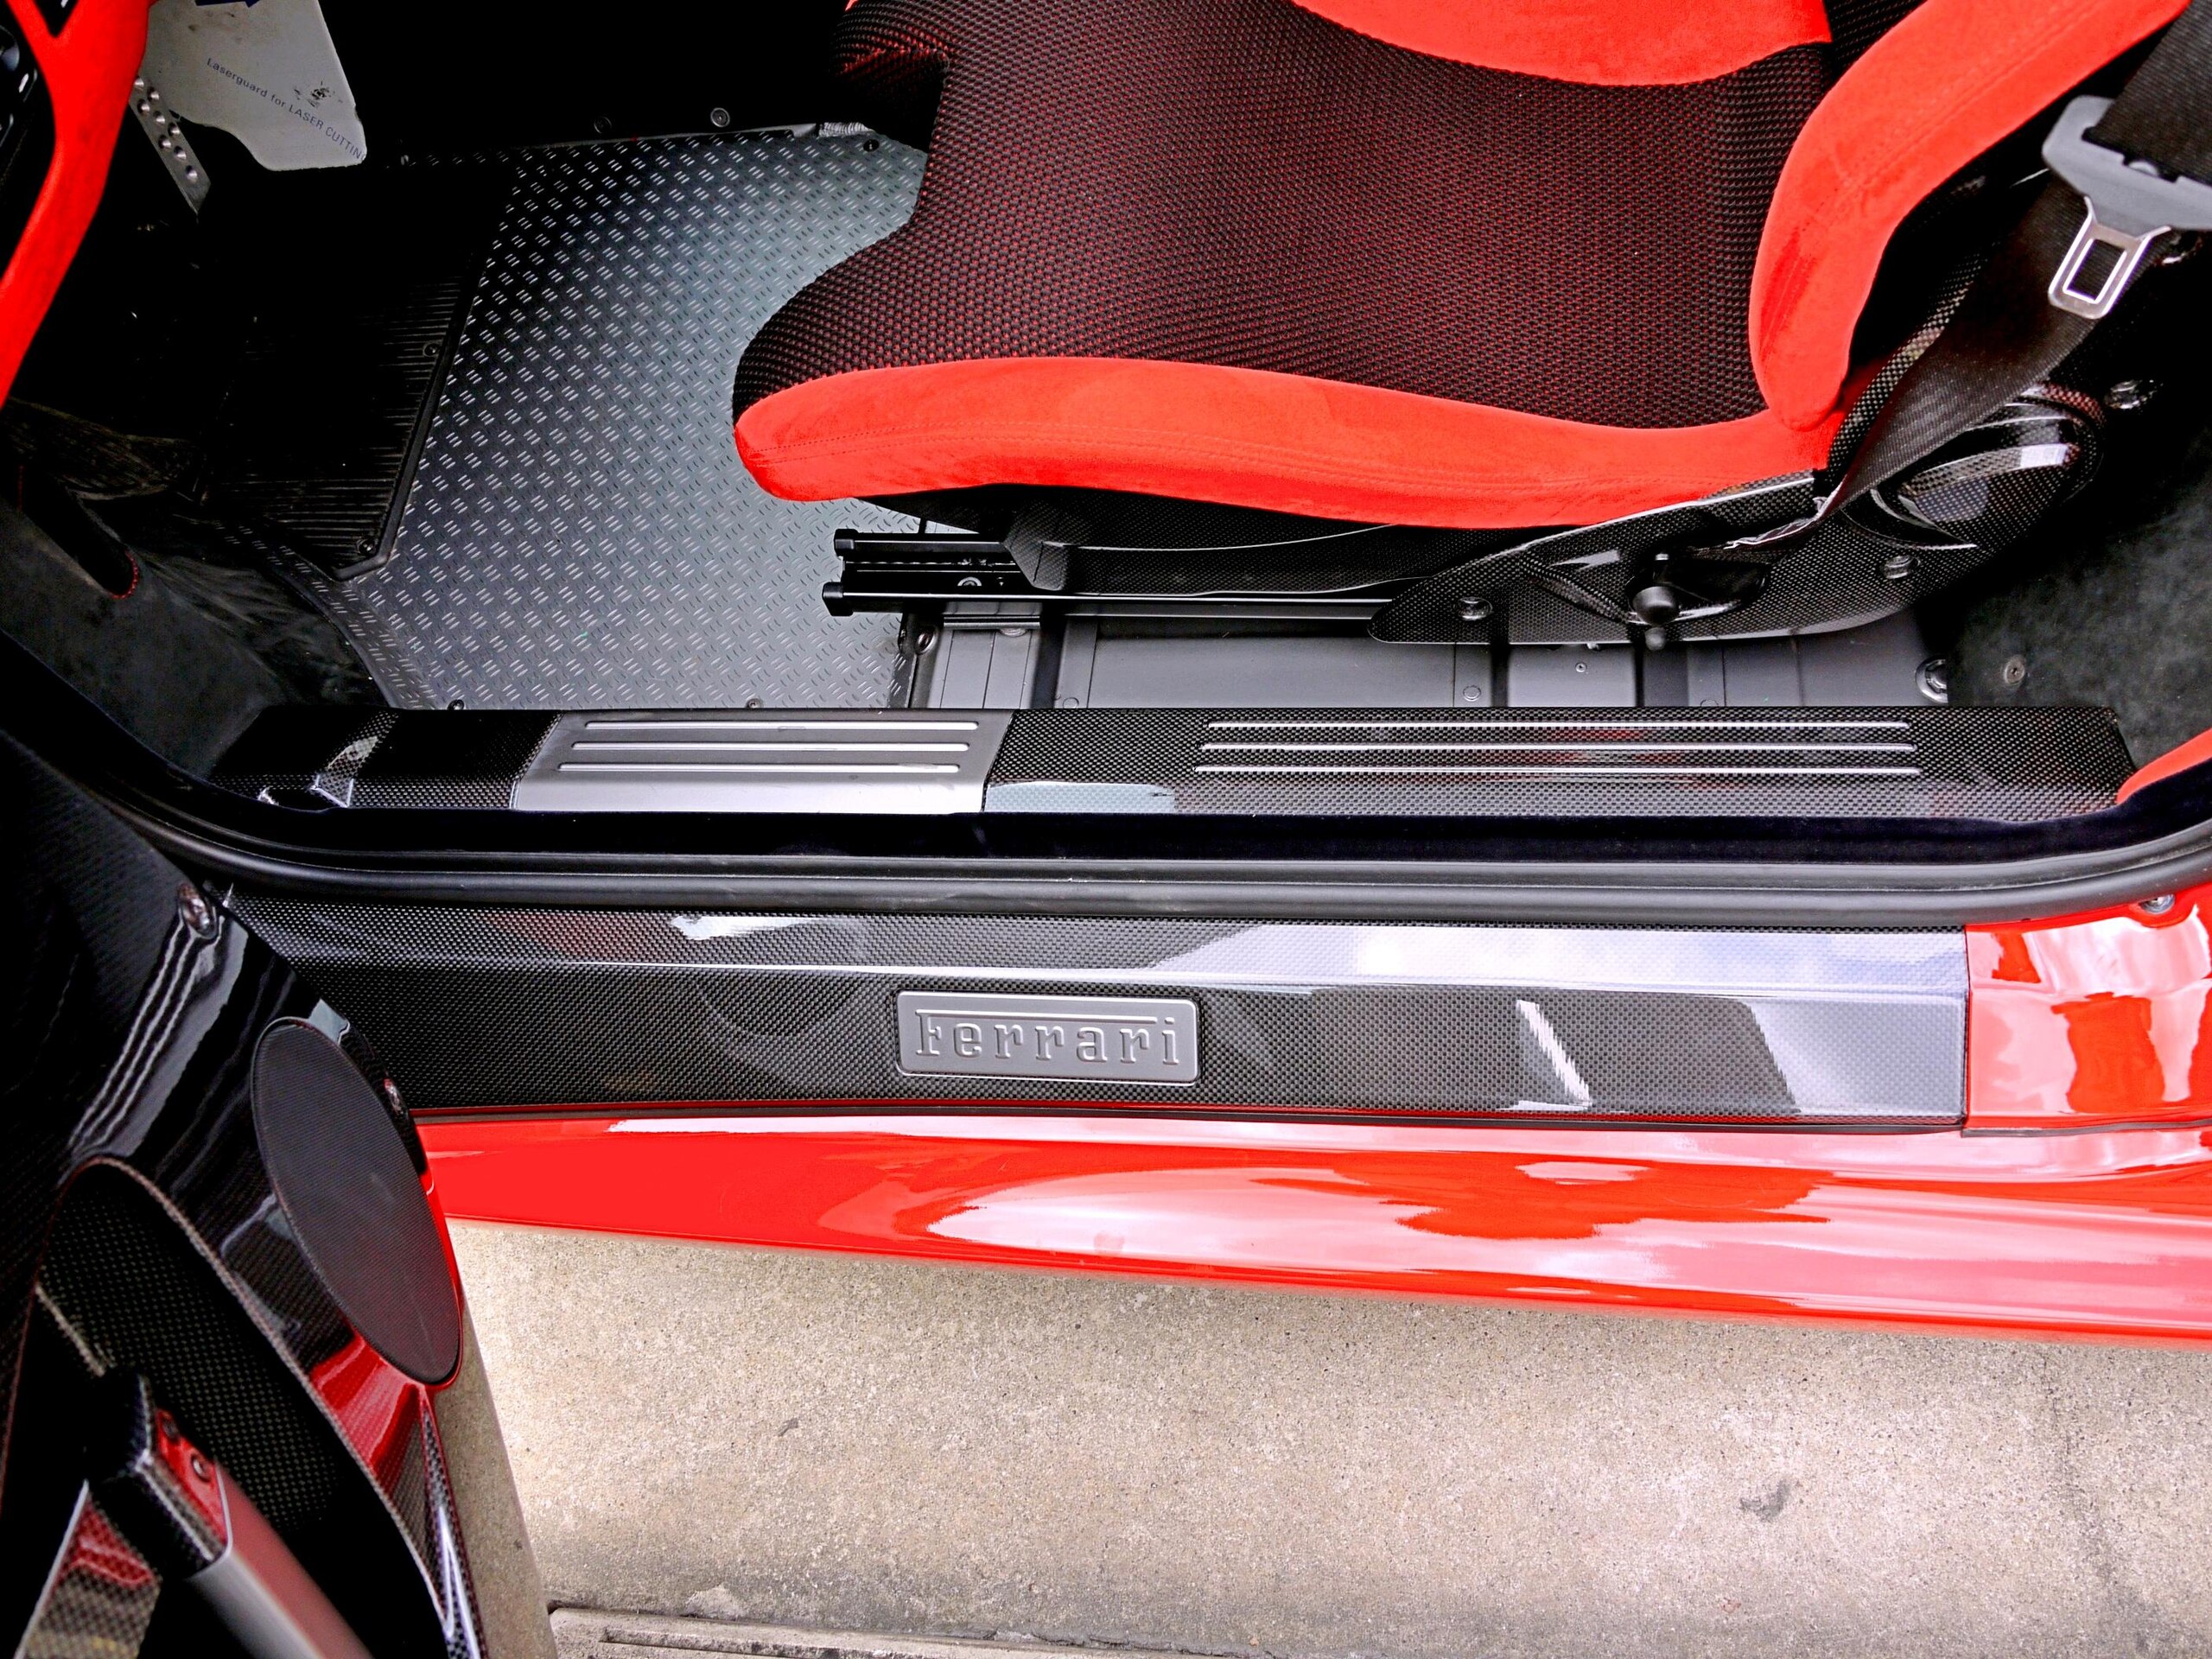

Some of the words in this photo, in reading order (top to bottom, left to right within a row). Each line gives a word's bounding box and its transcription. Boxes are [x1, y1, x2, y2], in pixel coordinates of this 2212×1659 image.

[207, 57, 268, 98] Laserguard
[270, 94, 286, 108] for
[288, 105, 324, 130] LASER
[914, 1008, 1180, 1065] Ferrari
